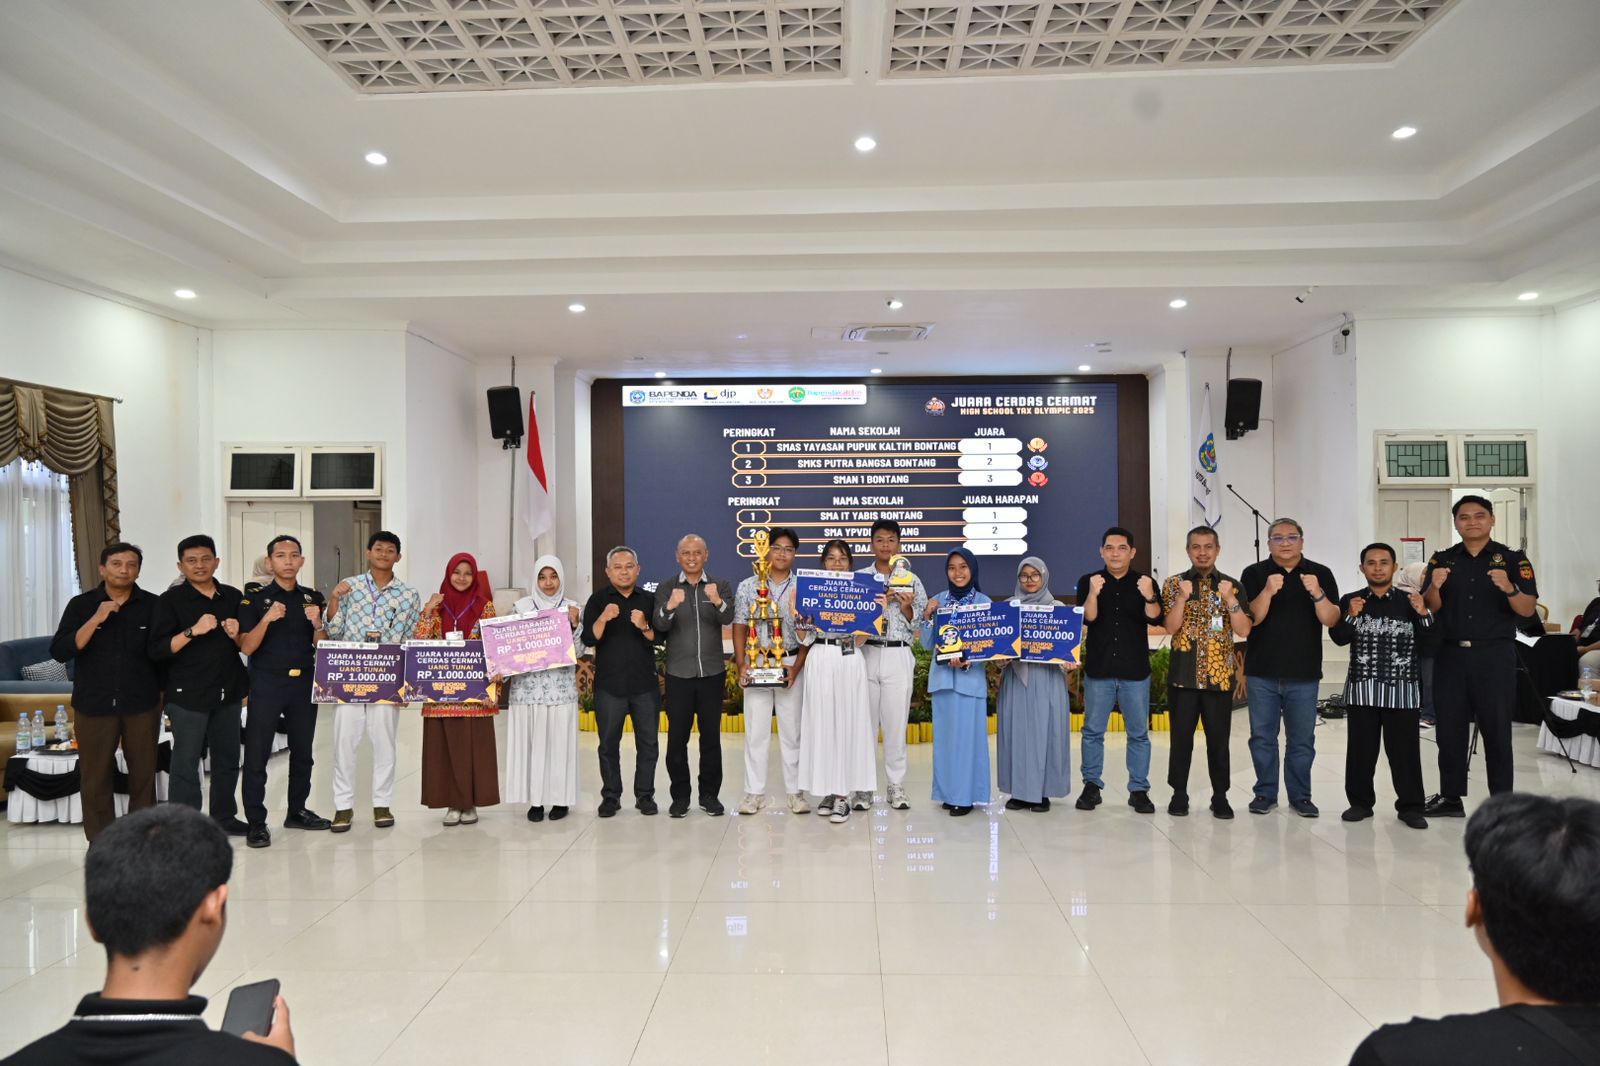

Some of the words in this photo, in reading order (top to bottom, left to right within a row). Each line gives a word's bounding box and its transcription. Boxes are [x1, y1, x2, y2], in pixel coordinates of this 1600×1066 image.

[720, 389, 737, 400] djp
[951, 397, 992, 407] JUARA
[996, 396, 1043, 407] CERDAS
[1047, 396, 1098, 406] CERMAT
[723, 428, 776, 438] PERINGKAT
[830, 427, 856, 436] NAMA
[858, 426, 901, 436] SEKOLAH
[974, 428, 1005, 436] JUARA
[745, 443, 750, 452] 1
[776, 443, 801, 452] SMAS
[803, 443, 844, 451] YAYASAN
[846, 442, 877, 451] PUPUK
[878, 442, 912, 451] KALTIM
[914, 442, 956, 450] BONTANG
[745, 460, 752, 468] 2
[798, 459, 822, 468] SMKS
[824, 459, 854, 468] PUTRA
[856, 459, 892, 468] BANGSA
[894, 459, 936, 467] BONTANG
[745, 476, 752, 484] 3
[833, 476, 858, 484] SMAN
[860, 476, 865, 484] 1
[867, 475, 909, 484] BONTANG
[728, 497, 780, 506] PERINGKAT
[833, 497, 859, 505] NAMA
[861, 496, 904, 505] SEKOLAH
[962, 496, 993, 504] JUARA
[995, 495, 1039, 504] HARAPAN
[751, 512, 755, 521] 1
[820, 512, 839, 521] SMA
[841, 512, 849, 520] IT
[851, 512, 878, 520] YABIS
[881, 511, 923, 520] BONTANG
[824, 528, 843, 537] SMA
[802, 598, 821, 607] RP.
[825, 599, 876, 611] 5.000.000
[492, 625, 517, 634] JUARA
[519, 619, 555, 630] HARAPAN
[495, 631, 526, 640] CERDAS
[527, 625, 558, 635] CERMAT
[530, 632, 551, 640] TUNAI
[963, 626, 1014, 638] 4.000.000
[1023, 630, 1074, 640] 3.000.000
[497, 646, 515, 655] RP.
[517, 636, 561, 651] 1.000.000
[349, 673, 396, 681] 1.000.000
[417, 671, 434, 679] RP.
[438, 671, 484, 679] 1.000.000
